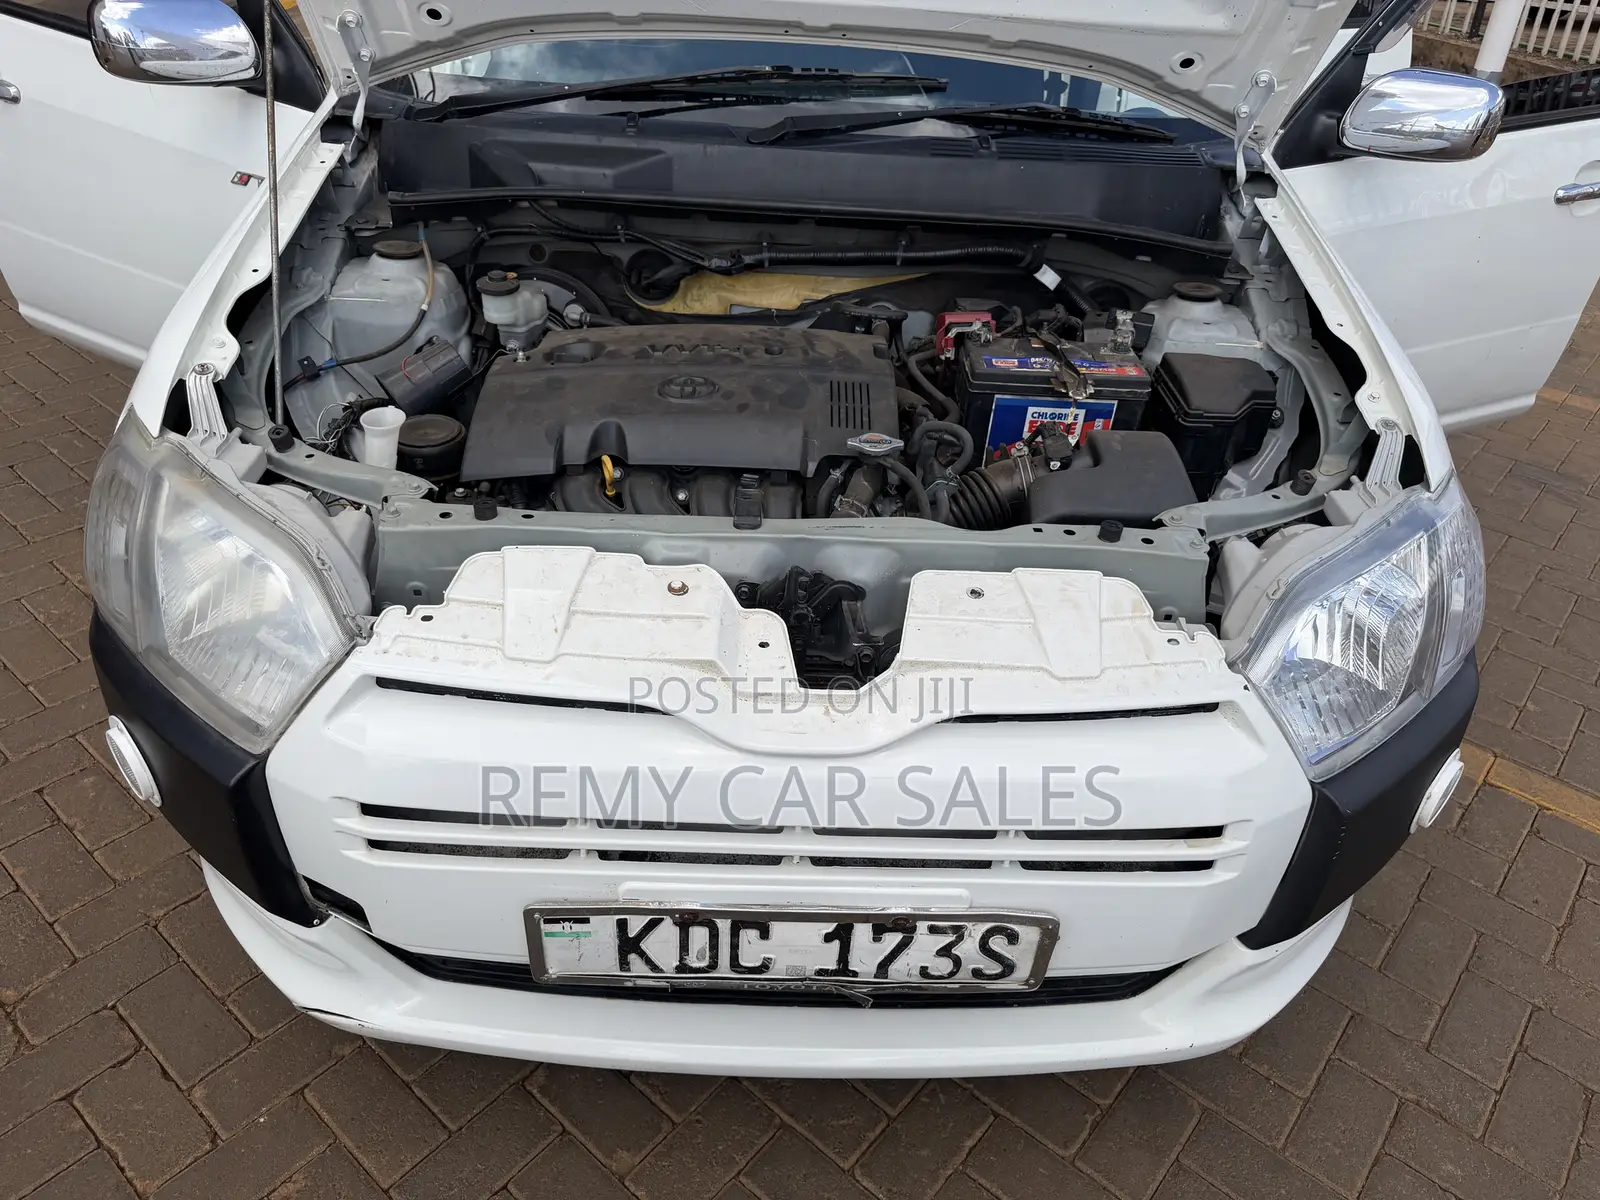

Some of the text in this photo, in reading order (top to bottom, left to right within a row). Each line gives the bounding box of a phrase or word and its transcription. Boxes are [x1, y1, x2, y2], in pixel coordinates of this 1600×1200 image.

[1031, 411, 1080, 421] CHLORIE
[1028, 420, 1078, 435] EDE
[615, 917, 1020, 981] KDC 173S
